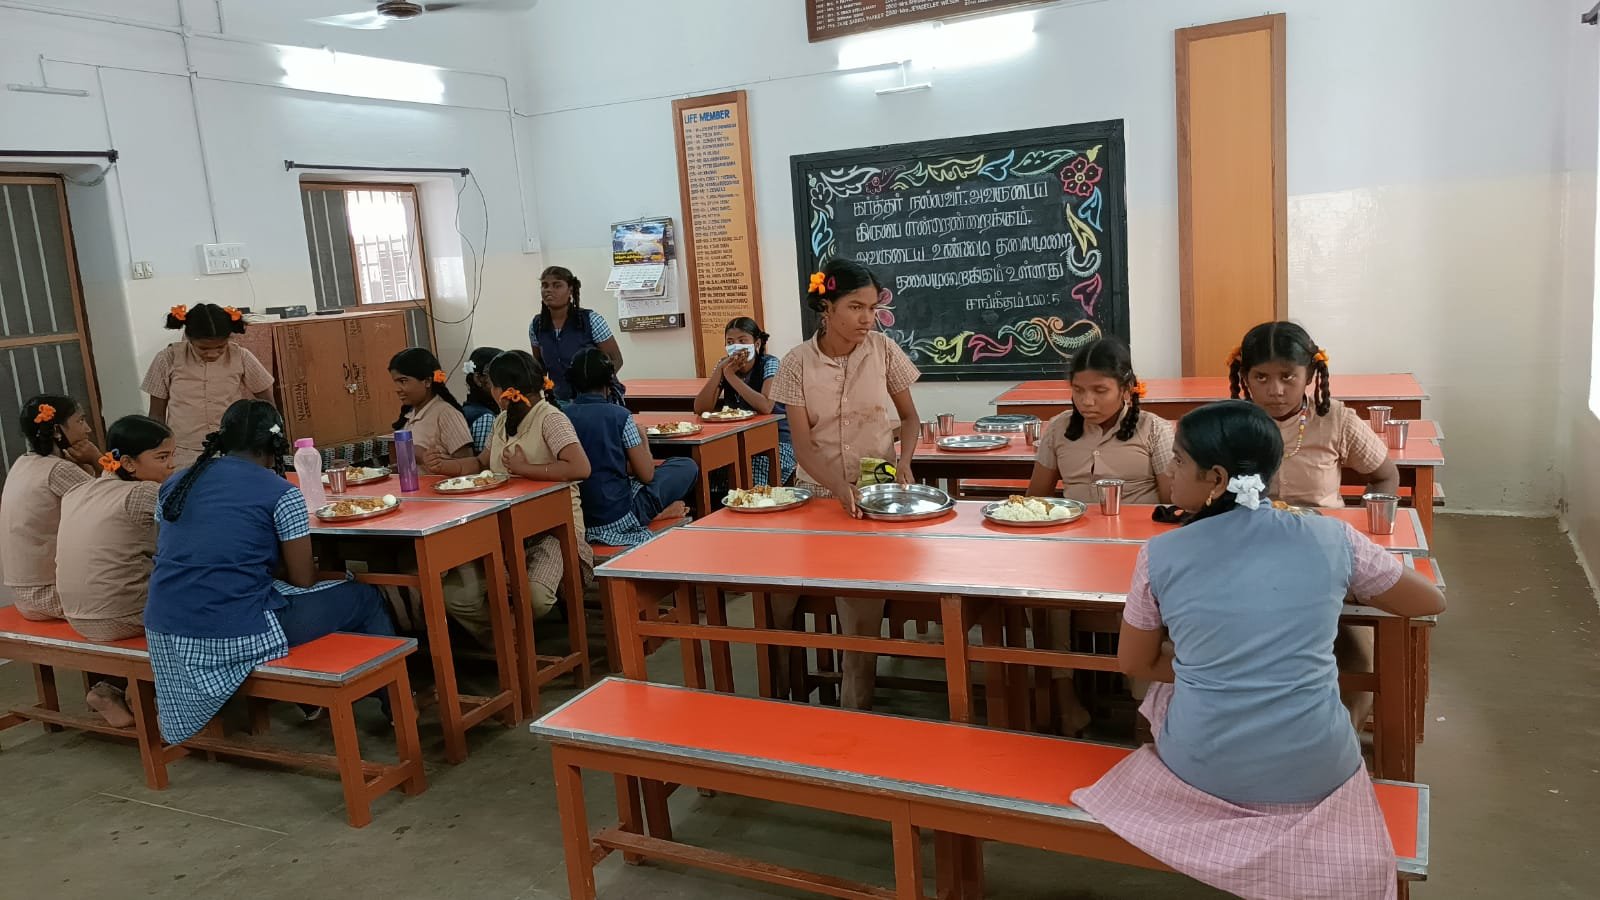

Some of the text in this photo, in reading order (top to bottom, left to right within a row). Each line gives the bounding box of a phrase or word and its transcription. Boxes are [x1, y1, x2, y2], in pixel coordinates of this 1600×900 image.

[684, 109, 730, 124] LIFE MEMBER
[853, 192, 904, 221] கர்த்தர்
[856, 222, 902, 243] கிருபை
[931, 235, 991, 260] உண்மை
[994, 232, 1075, 261] தலைமுறை
[895, 259, 1064, 295] தலைமுறைக்கும் உள்ளது
